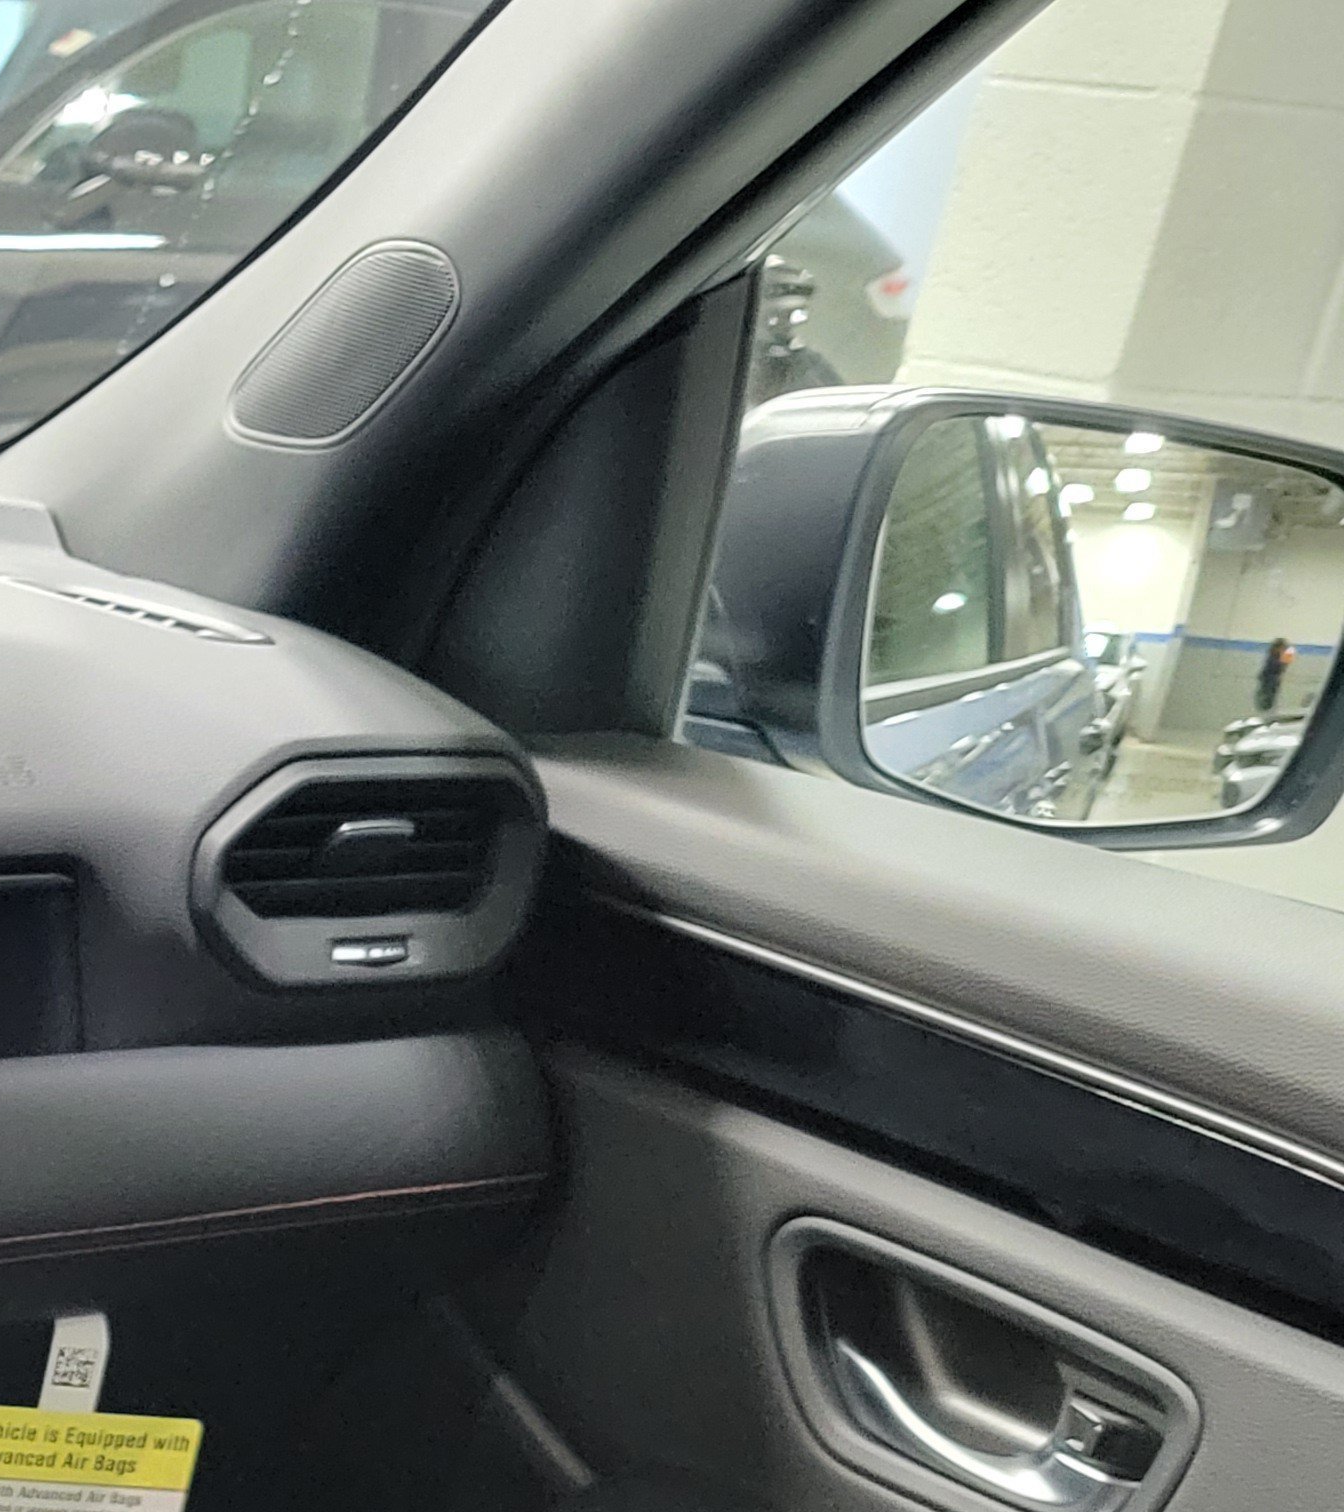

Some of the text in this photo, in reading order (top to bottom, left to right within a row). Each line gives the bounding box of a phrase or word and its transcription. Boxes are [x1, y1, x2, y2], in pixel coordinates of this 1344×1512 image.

[43, 1424, 60, 1444] is
[65, 1426, 148, 1450] Equipped
[152, 1432, 190, 1453] with
[63, 1452, 85, 1471] Air
[93, 1454, 138, 1475] Bags
[17, 1486, 82, 1503] Advanced
[85, 1490, 106, 1504] Air
[110, 1491, 142, 1507] Bags
